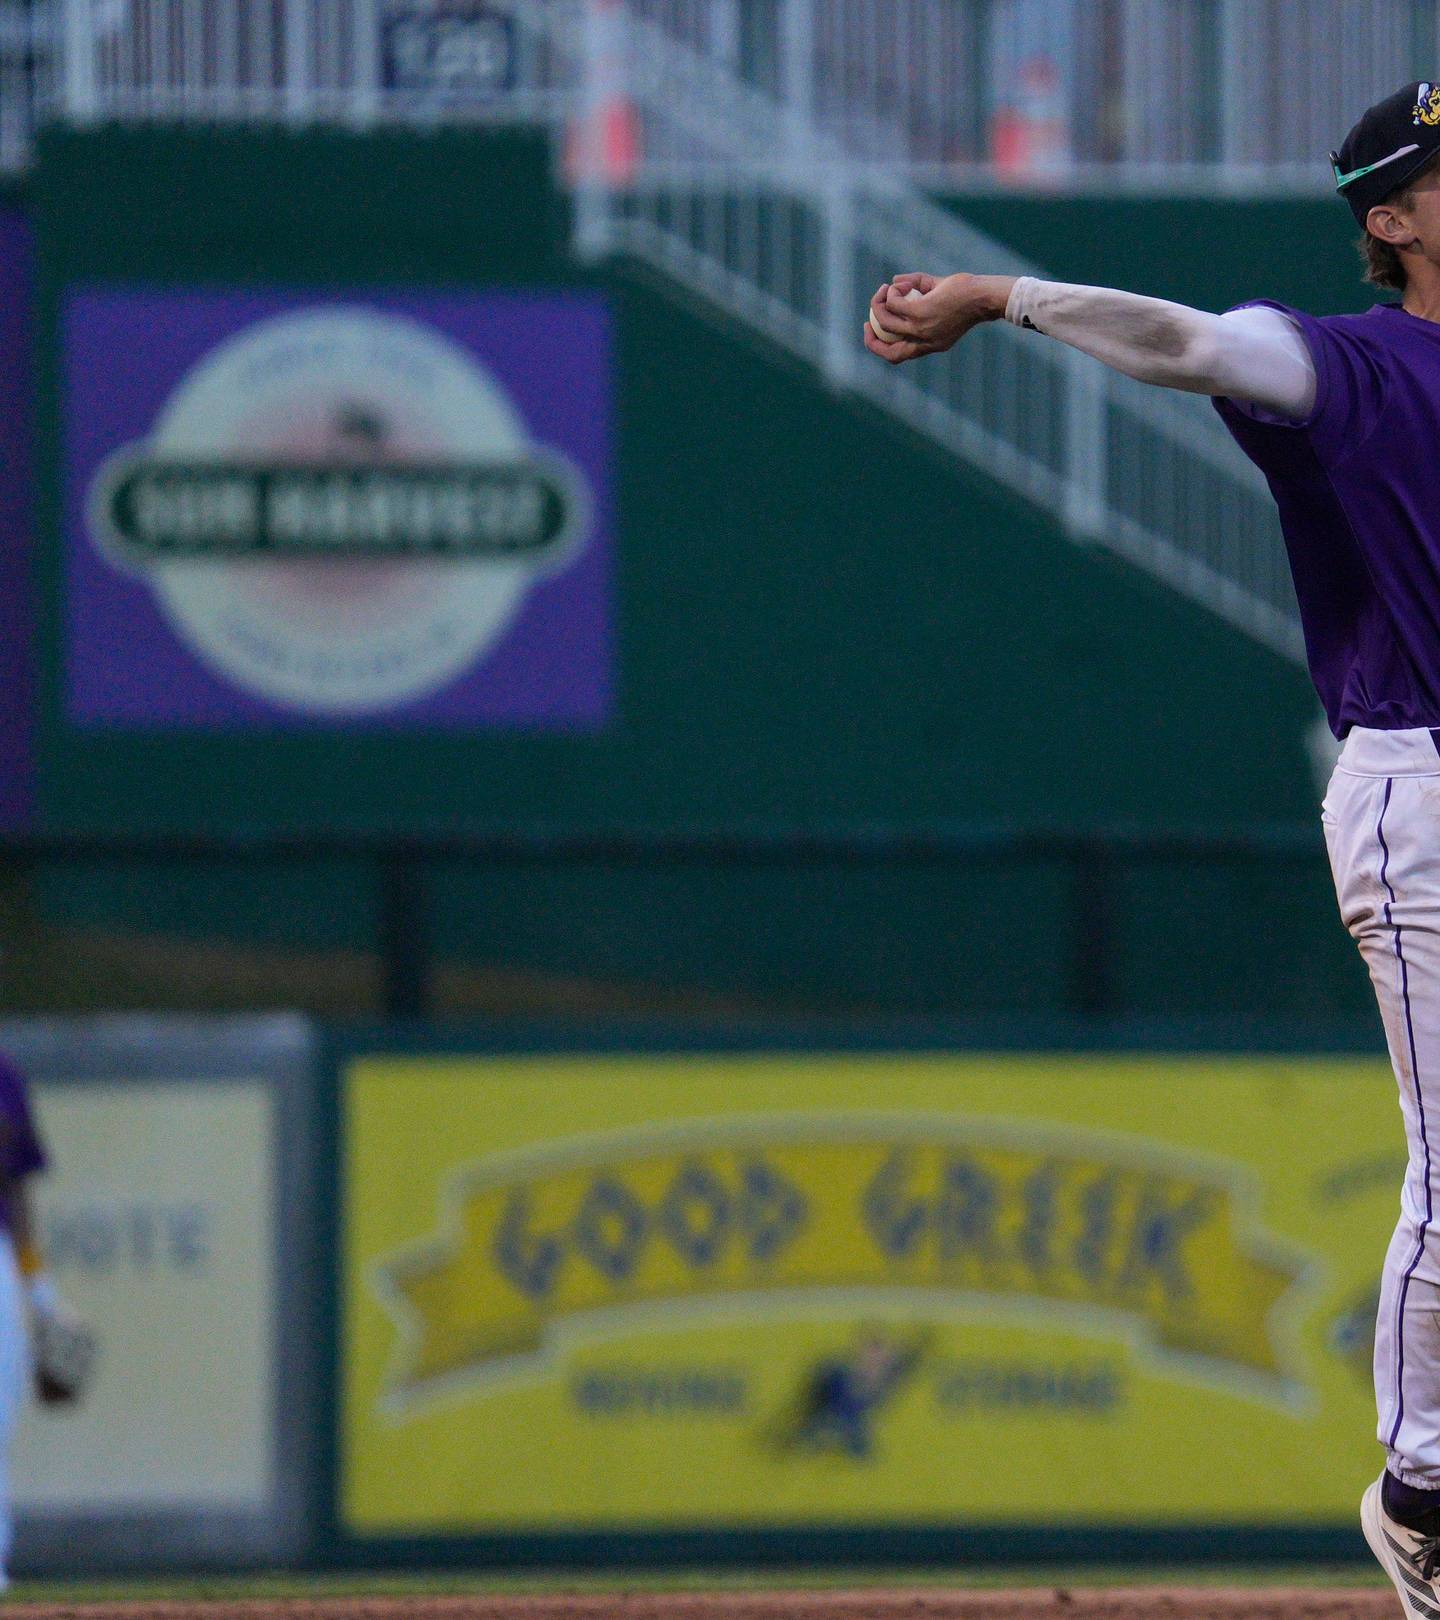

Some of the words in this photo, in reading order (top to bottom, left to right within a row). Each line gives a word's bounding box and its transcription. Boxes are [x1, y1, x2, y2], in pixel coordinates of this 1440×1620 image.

[134, 477, 254, 544] SUN
[266, 477, 545, 544] HARVEST
[490, 1147, 808, 1302] GOOD
[860, 1144, 1204, 1305] GREEK
